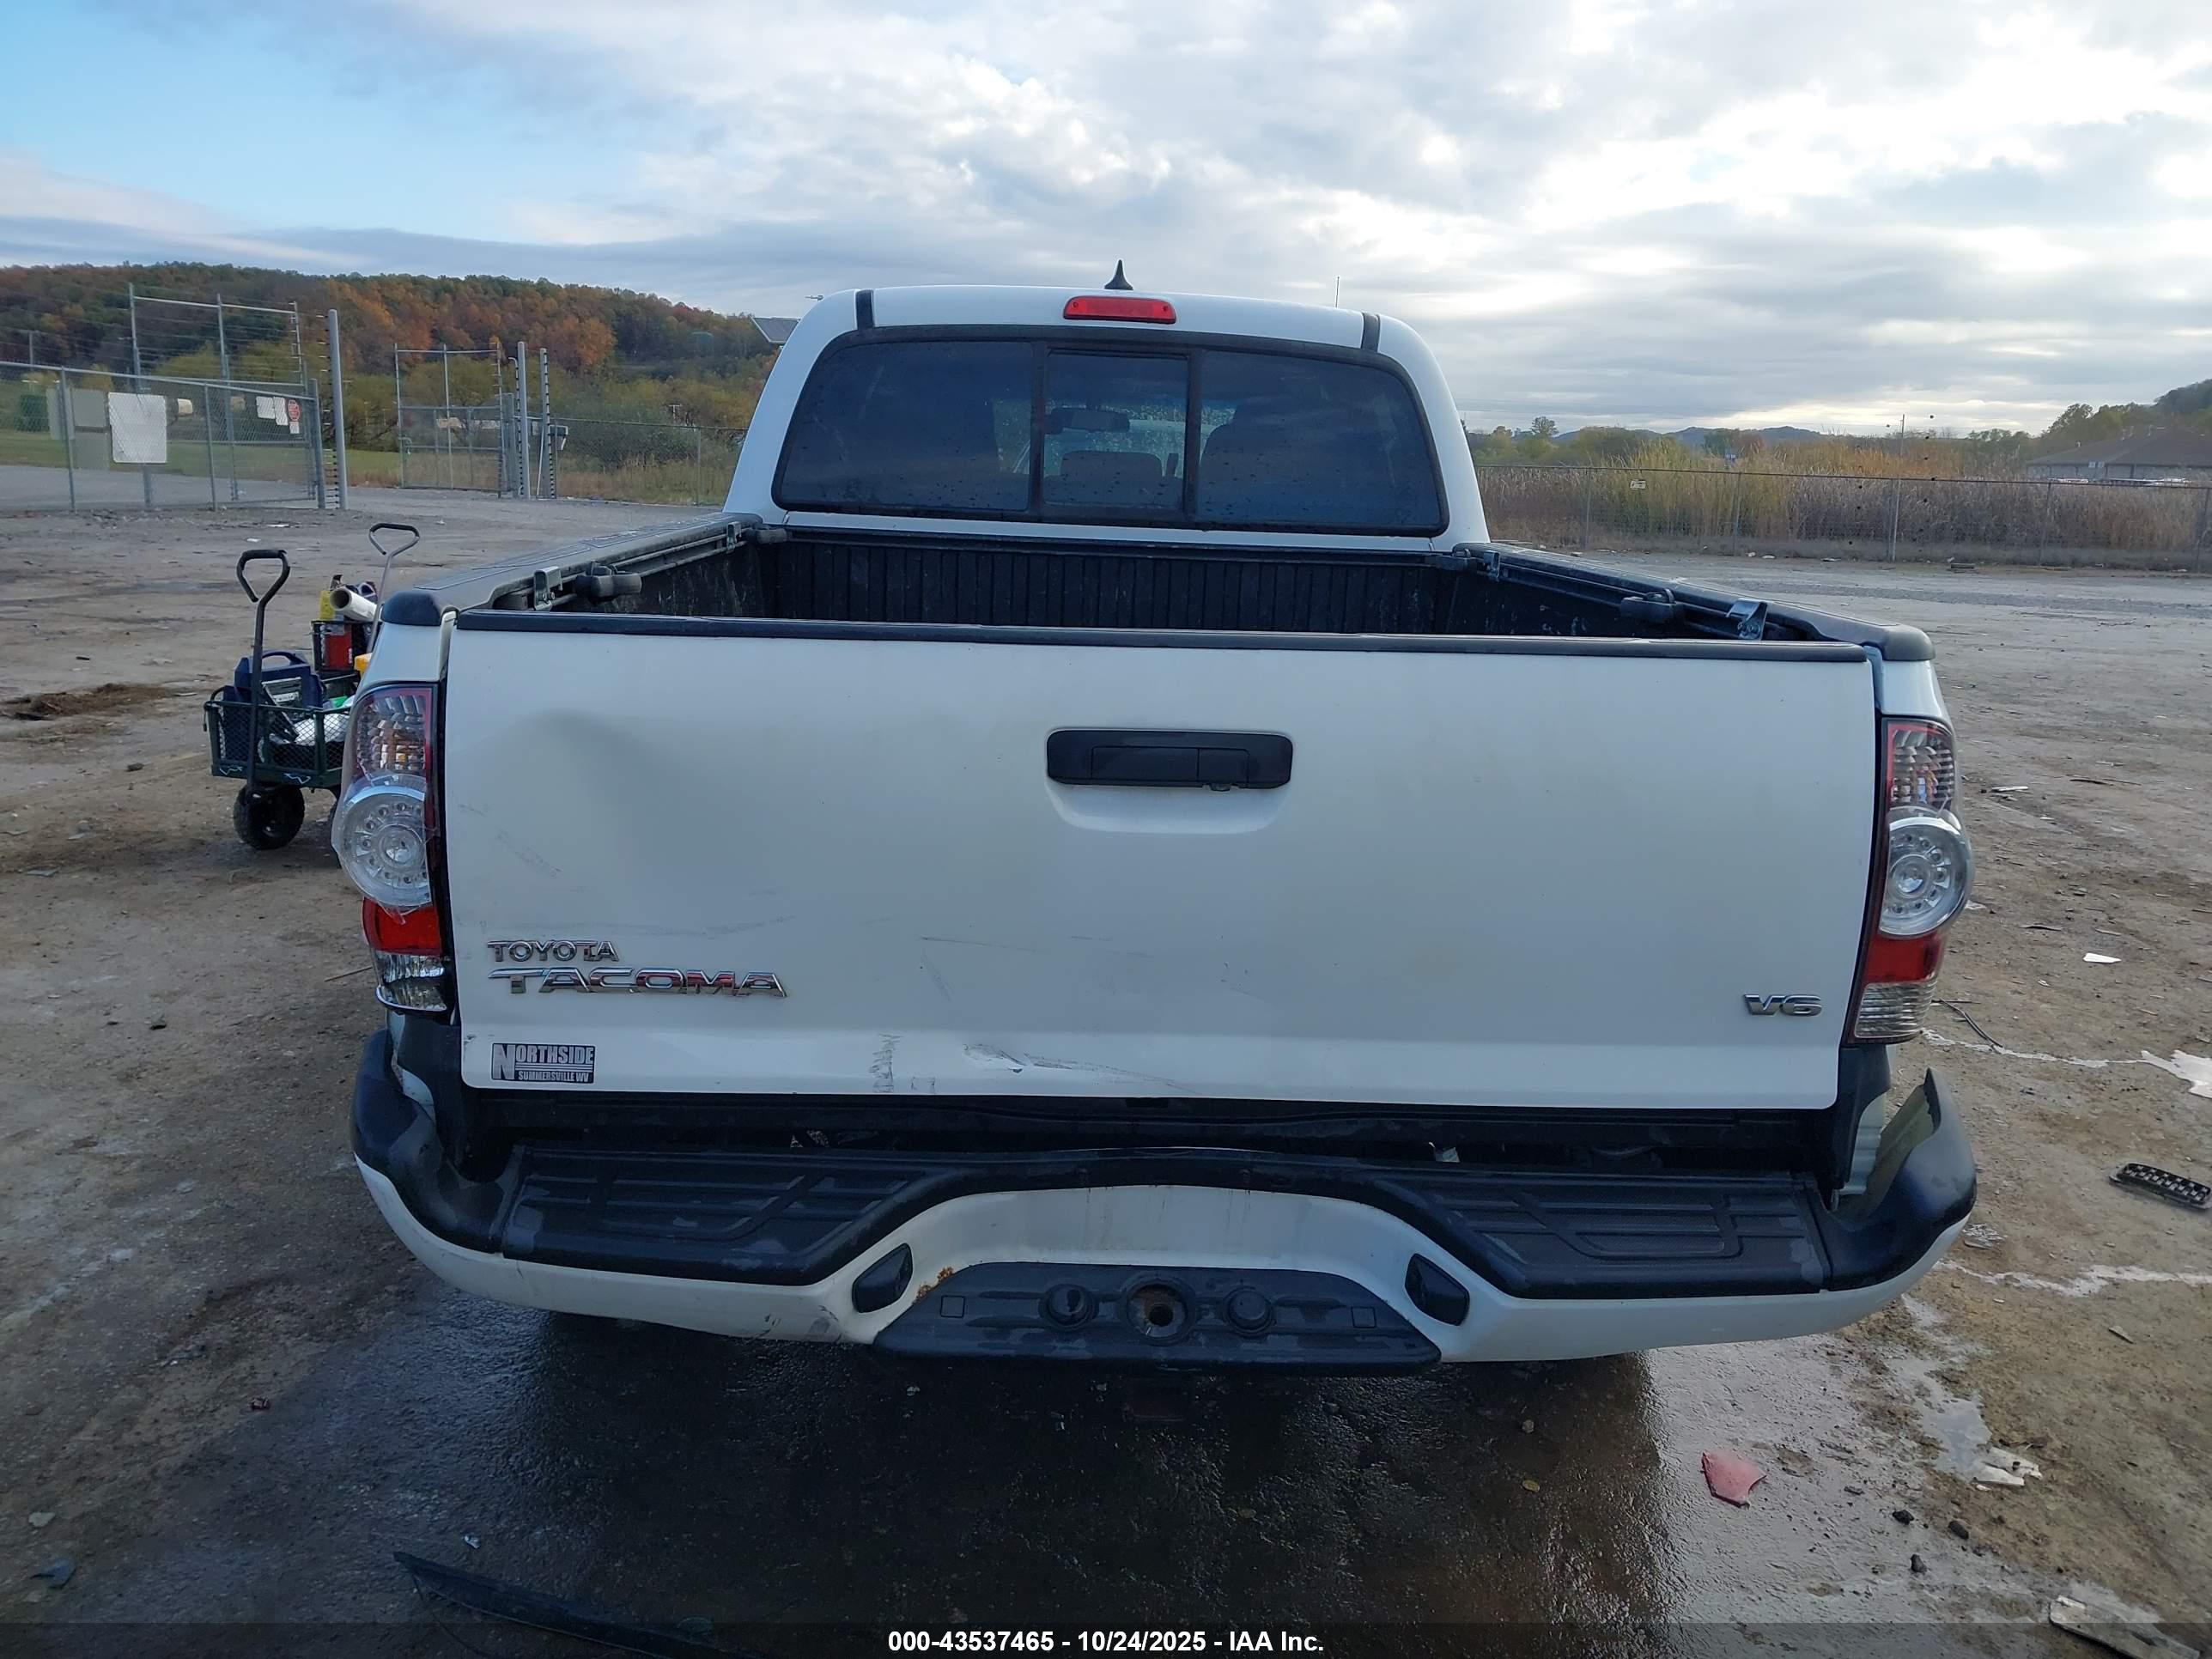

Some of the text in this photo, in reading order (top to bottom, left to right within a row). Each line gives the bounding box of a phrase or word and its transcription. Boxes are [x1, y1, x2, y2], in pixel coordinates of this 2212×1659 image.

[487, 940, 619, 962] TOYOTA
[488, 968, 787, 997] TACOMA
[1744, 994, 1822, 1016] V6
[493, 1044, 593, 1080] NORTHSIDE
[519, 1071, 589, 1082] SUMMERSVILLE WV
